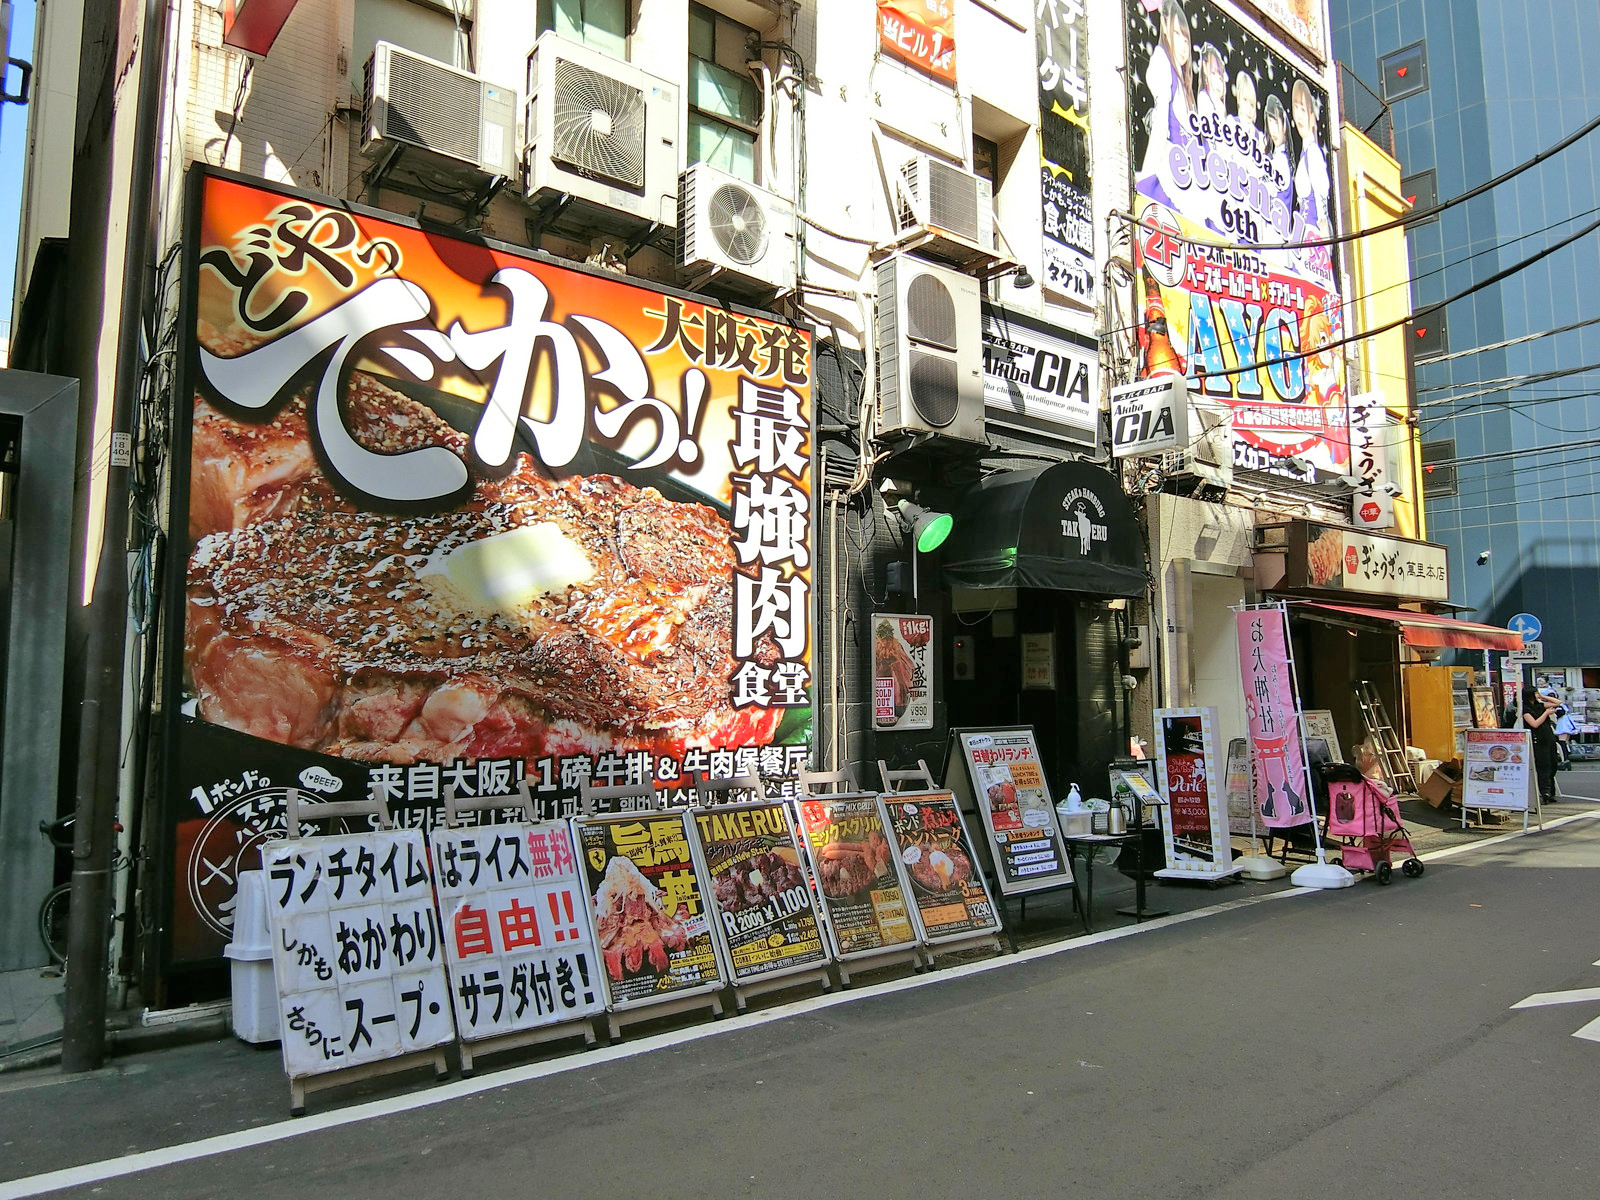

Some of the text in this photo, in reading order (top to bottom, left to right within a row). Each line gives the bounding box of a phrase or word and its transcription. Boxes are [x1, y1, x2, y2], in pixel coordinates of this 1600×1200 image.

[1168, 138, 1306, 258] eternal
[1043, 201, 1093, 255] 食べ放題
[1220, 199, 1259, 243] 6th
[1143, 216, 1183, 269] 2F
[200, 205, 401, 332] どやっ
[1048, 261, 1085, 296] タケル
[642, 296, 808, 385] 大阪発
[1009, 341, 1030, 354] BAR
[199, 266, 706, 502] でかっ!
[982, 347, 1090, 404] Akiba CIA
[1143, 384, 1165, 395] BAR
[1026, 391, 1066, 409] intelligence
[1066, 404, 1090, 416] agency
[1114, 404, 1143, 416] Akiba
[1113, 406, 1175, 446] CIA
[112, 448, 130, 456] 404
[1351, 399, 1384, 498] ぎょうざ
[1062, 487, 1079, 510] STEAK
[1082, 487, 1106, 518] HAMBURG
[1360, 507, 1379, 517] 中華
[731, 660, 810, 708] 食堂
[876, 688, 892, 697] SOLD
[877, 698, 891, 706] OUT
[971, 746, 1035, 764] 日替わりランチ!
[189, 768, 271, 815] 1ポンドの
[235, 811, 321, 844] ハンバグ
[696, 807, 783, 843] TAKERU
[809, 816, 882, 848] ミックスグリル
[899, 826, 962, 847] ハンバーグ
[269, 841, 429, 909] ランチタイム
[281, 907, 437, 981] しかも おかわり
[453, 890, 581, 960] 自由!!
[721, 911, 740, 937] R
[737, 911, 765, 932] 200g
[458, 953, 596, 1028] サラダ付き!
[287, 1006, 345, 1060] さらに
